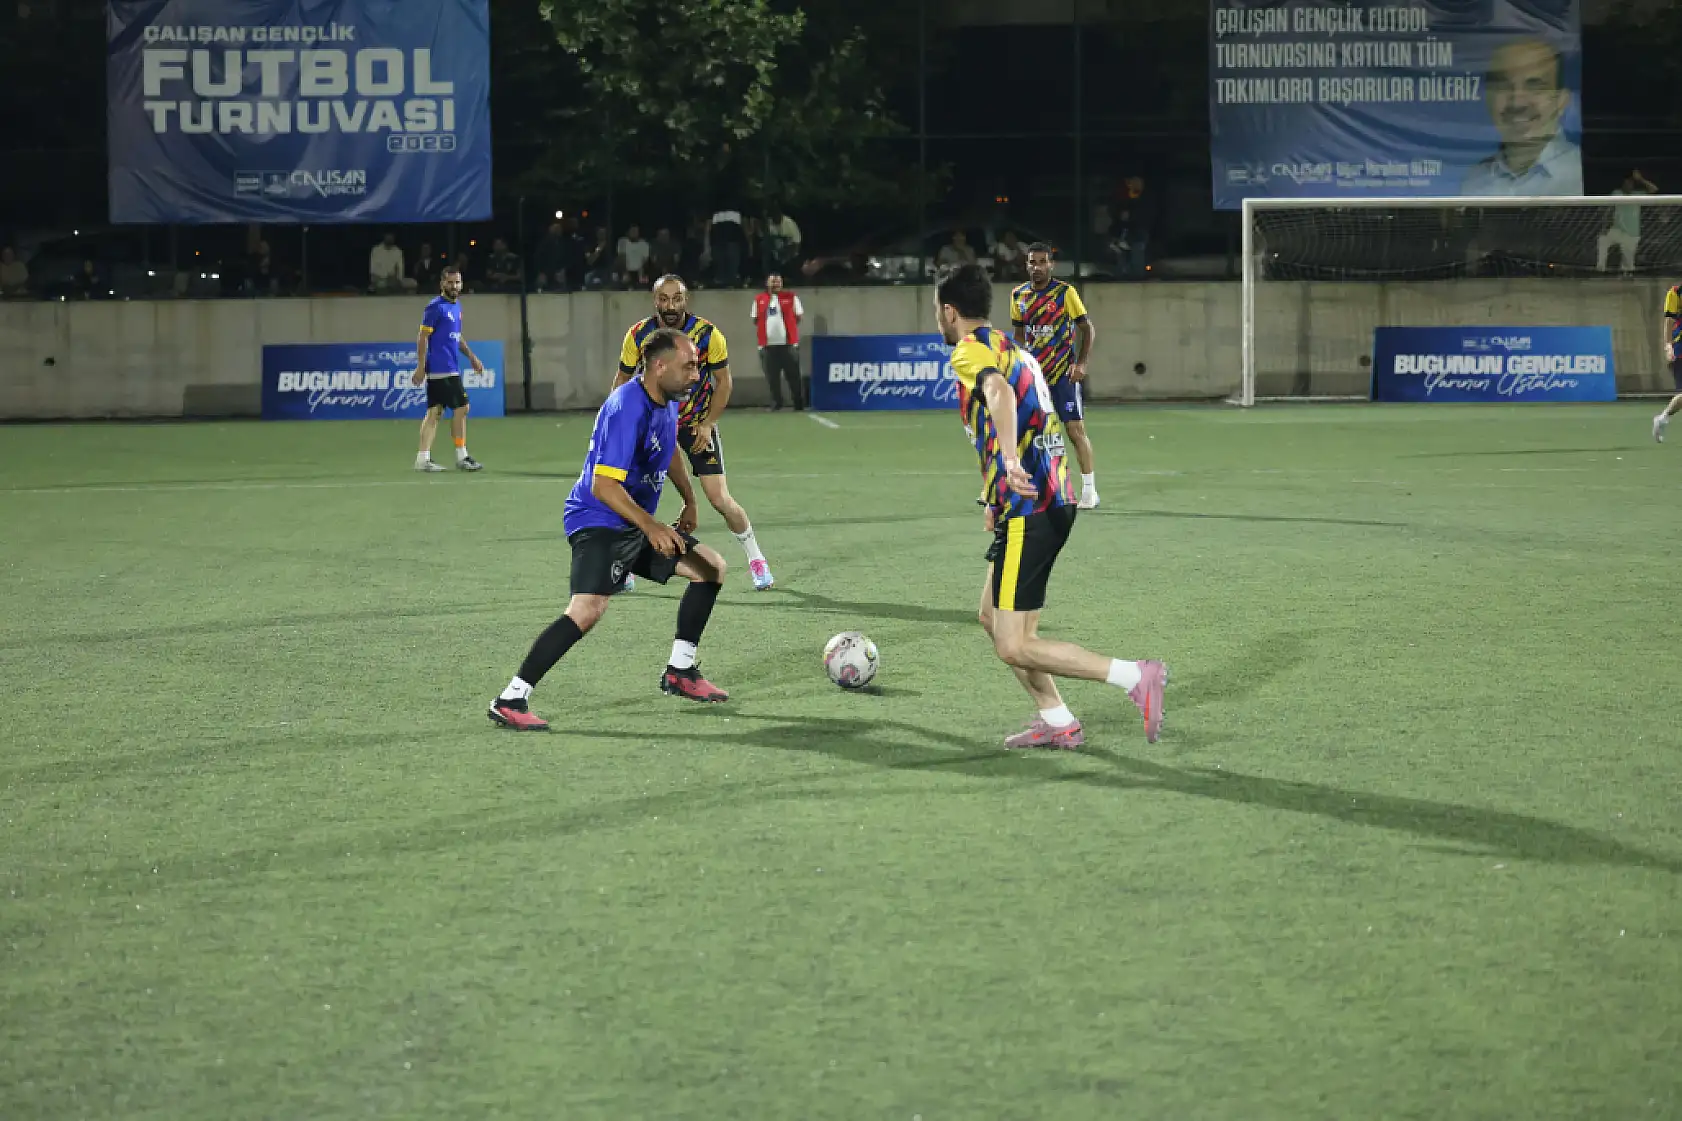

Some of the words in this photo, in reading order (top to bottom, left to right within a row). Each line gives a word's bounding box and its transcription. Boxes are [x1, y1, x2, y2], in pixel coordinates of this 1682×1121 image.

[143, 25, 246, 44] ÇALIŞAN
[252, 22, 355, 43] GENÇLİK
[1215, 8, 1288, 38] ÇALIŞAN
[1294, 2, 1363, 38] GENÇLİK
[1368, 7, 1429, 32] FUTBOL
[1215, 42, 1334, 69] TURNUVASINA
[1341, 42, 1412, 67] KATILAN
[1417, 36, 1454, 66] TÜM
[143, 48, 454, 96] FUTBOL
[1215, 78, 1314, 104] TAKIMLARA
[1319, 77, 1414, 107] BAŞARILAR
[1419, 76, 1481, 102] DİLERİZ
[143, 99, 456, 134] TURNUVASI
